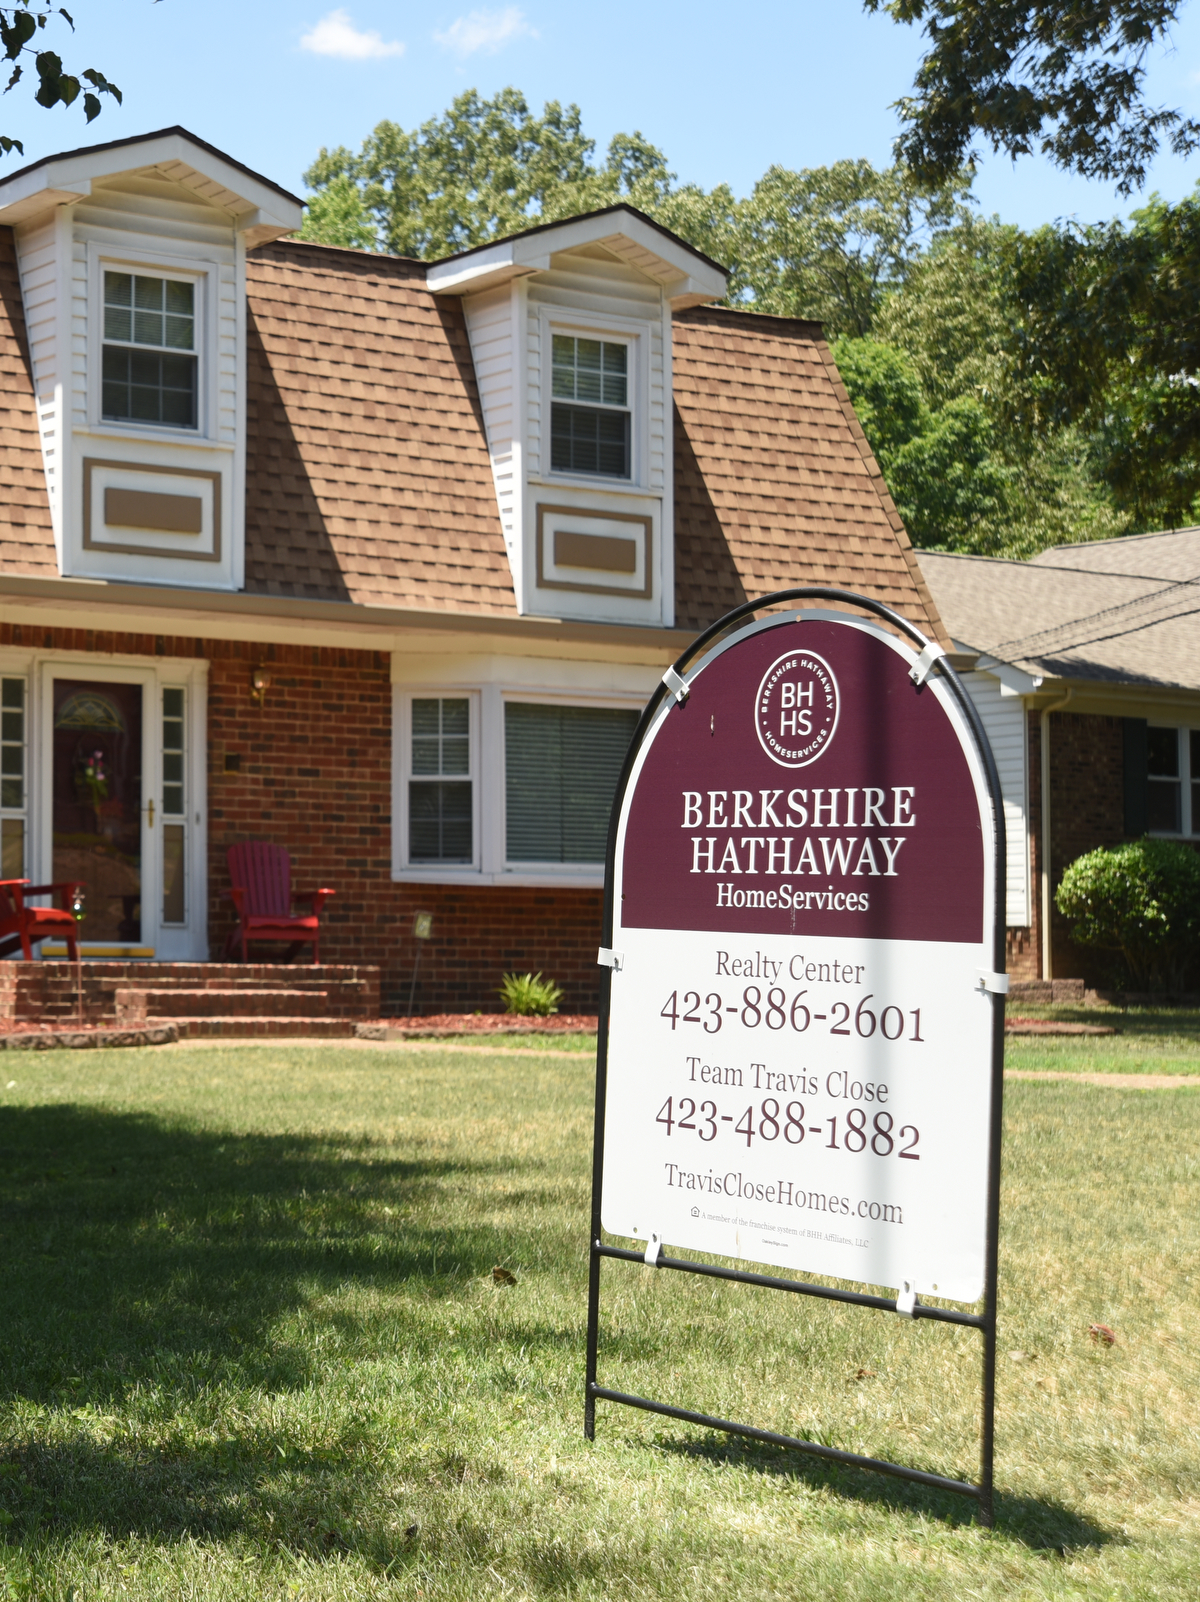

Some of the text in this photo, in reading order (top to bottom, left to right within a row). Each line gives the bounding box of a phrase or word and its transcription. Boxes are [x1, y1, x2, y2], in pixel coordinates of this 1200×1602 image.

[761, 659, 834, 713] BERKSHIRE HATHAWAY
[781, 681, 814, 709] BH
[780, 709, 813, 737] HS
[764, 729, 828, 759] HOMESERVICES
[681, 787, 917, 829] BERKSHIRE
[689, 837, 907, 877] HATHAWAY
[716, 883, 870, 912] HomeServices
[715, 950, 866, 986] Realty Center
[660, 985, 925, 1042] 423-886-2601
[686, 1056, 890, 1104] Team Travis Close
[655, 1095, 921, 1161] 423-488-1882
[664, 1162, 905, 1225] TravisCloseHomes.com
[701, 1211, 869, 1248] A member of the franchise system of BHH Affiliates, LLC
